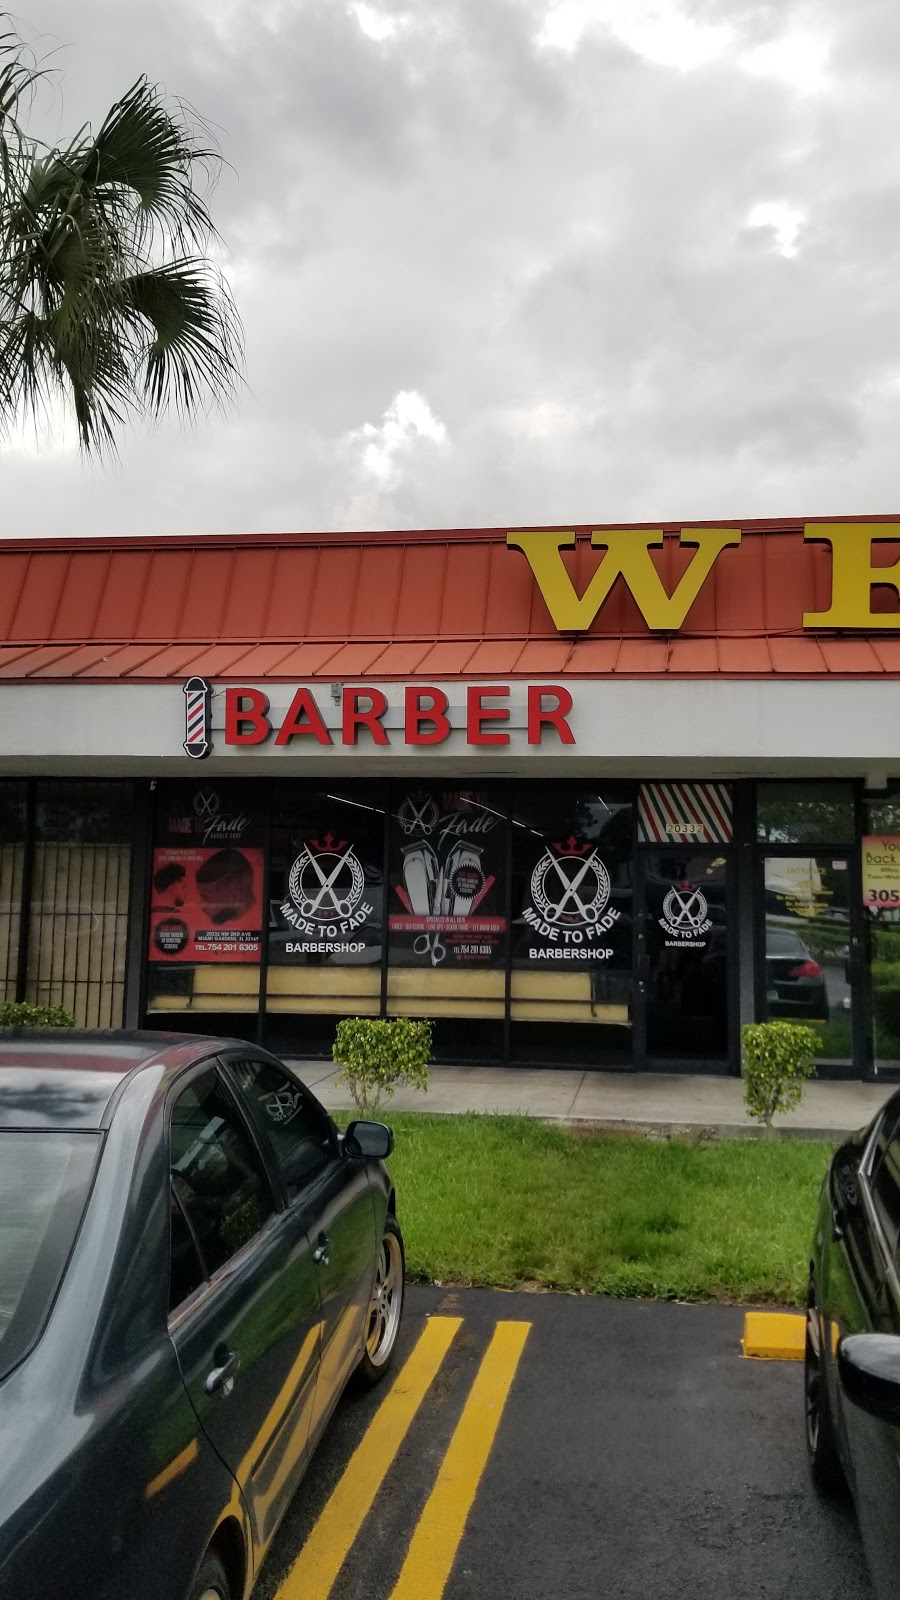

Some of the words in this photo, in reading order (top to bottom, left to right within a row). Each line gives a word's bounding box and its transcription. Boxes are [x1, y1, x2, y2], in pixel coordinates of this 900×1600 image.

[224, 684, 576, 746] BARBER
[202, 808, 252, 845] Fade
[438, 811, 501, 851] Fade
[667, 824, 703, 833] 20332
[866, 853, 896, 864] Back
[868, 889, 900, 903] 305
[279, 902, 315, 936] MADE
[318, 927, 338, 938] TO
[340, 902, 373, 935] FADE
[521, 906, 560, 941] MADE
[563, 930, 584, 943] TO
[586, 906, 622, 941] FADE
[658, 918, 680, 938] MADE
[680, 931, 692, 939] TO
[693, 919, 713, 937] FADE
[223, 943, 237, 951] 201
[285, 942, 366, 953] BARBERSHOP
[664, 940, 707, 948] BARBERSHOP
[529, 948, 614, 959] BARBERSHOP
